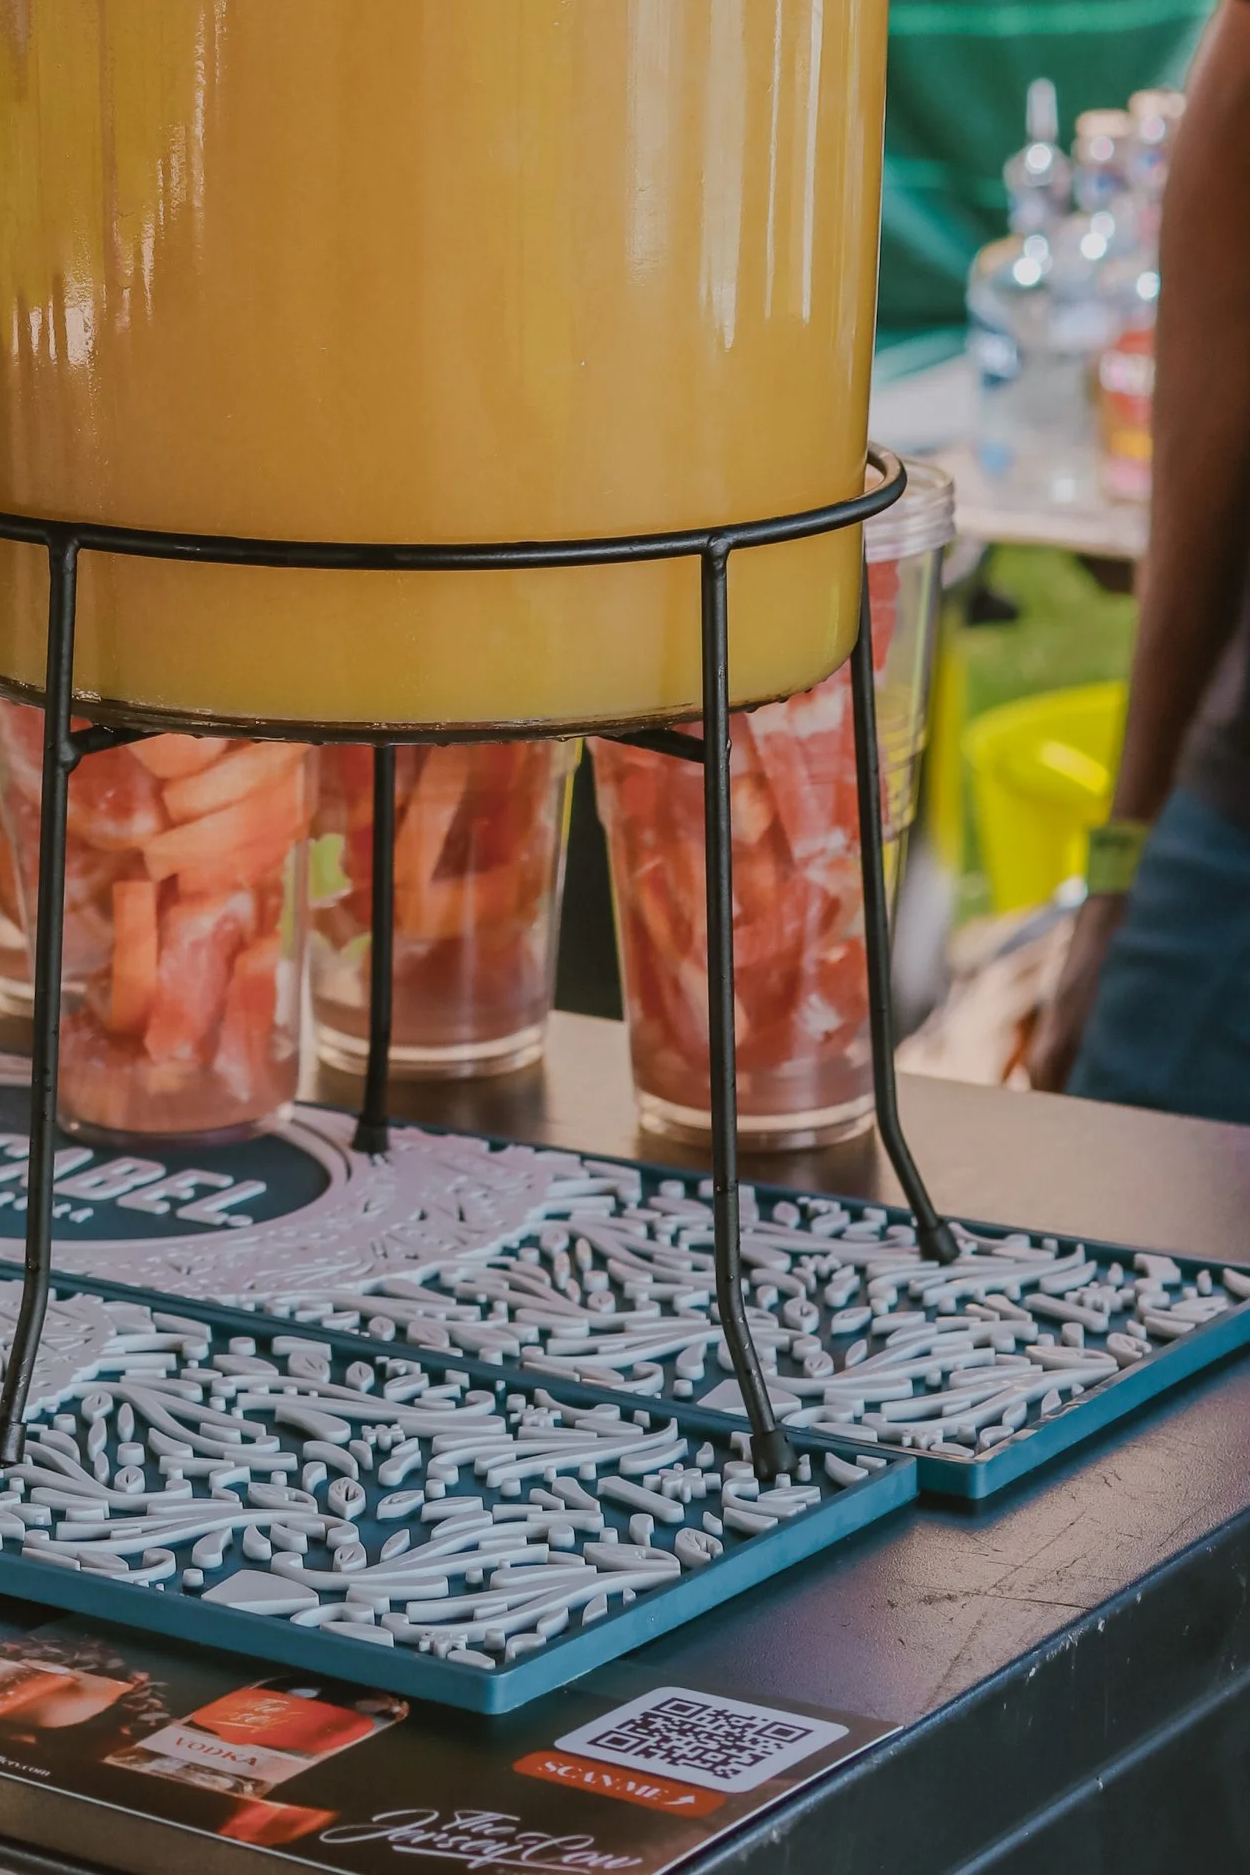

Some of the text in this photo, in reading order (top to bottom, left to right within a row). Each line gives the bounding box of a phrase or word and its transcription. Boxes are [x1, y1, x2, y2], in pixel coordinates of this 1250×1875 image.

[175, 1736, 258, 1767] VODKA
[540, 1760, 667, 1801] SCAN ME
[443, 1809, 521, 1833] The
[319, 1809, 643, 1870] Jersey Cow
